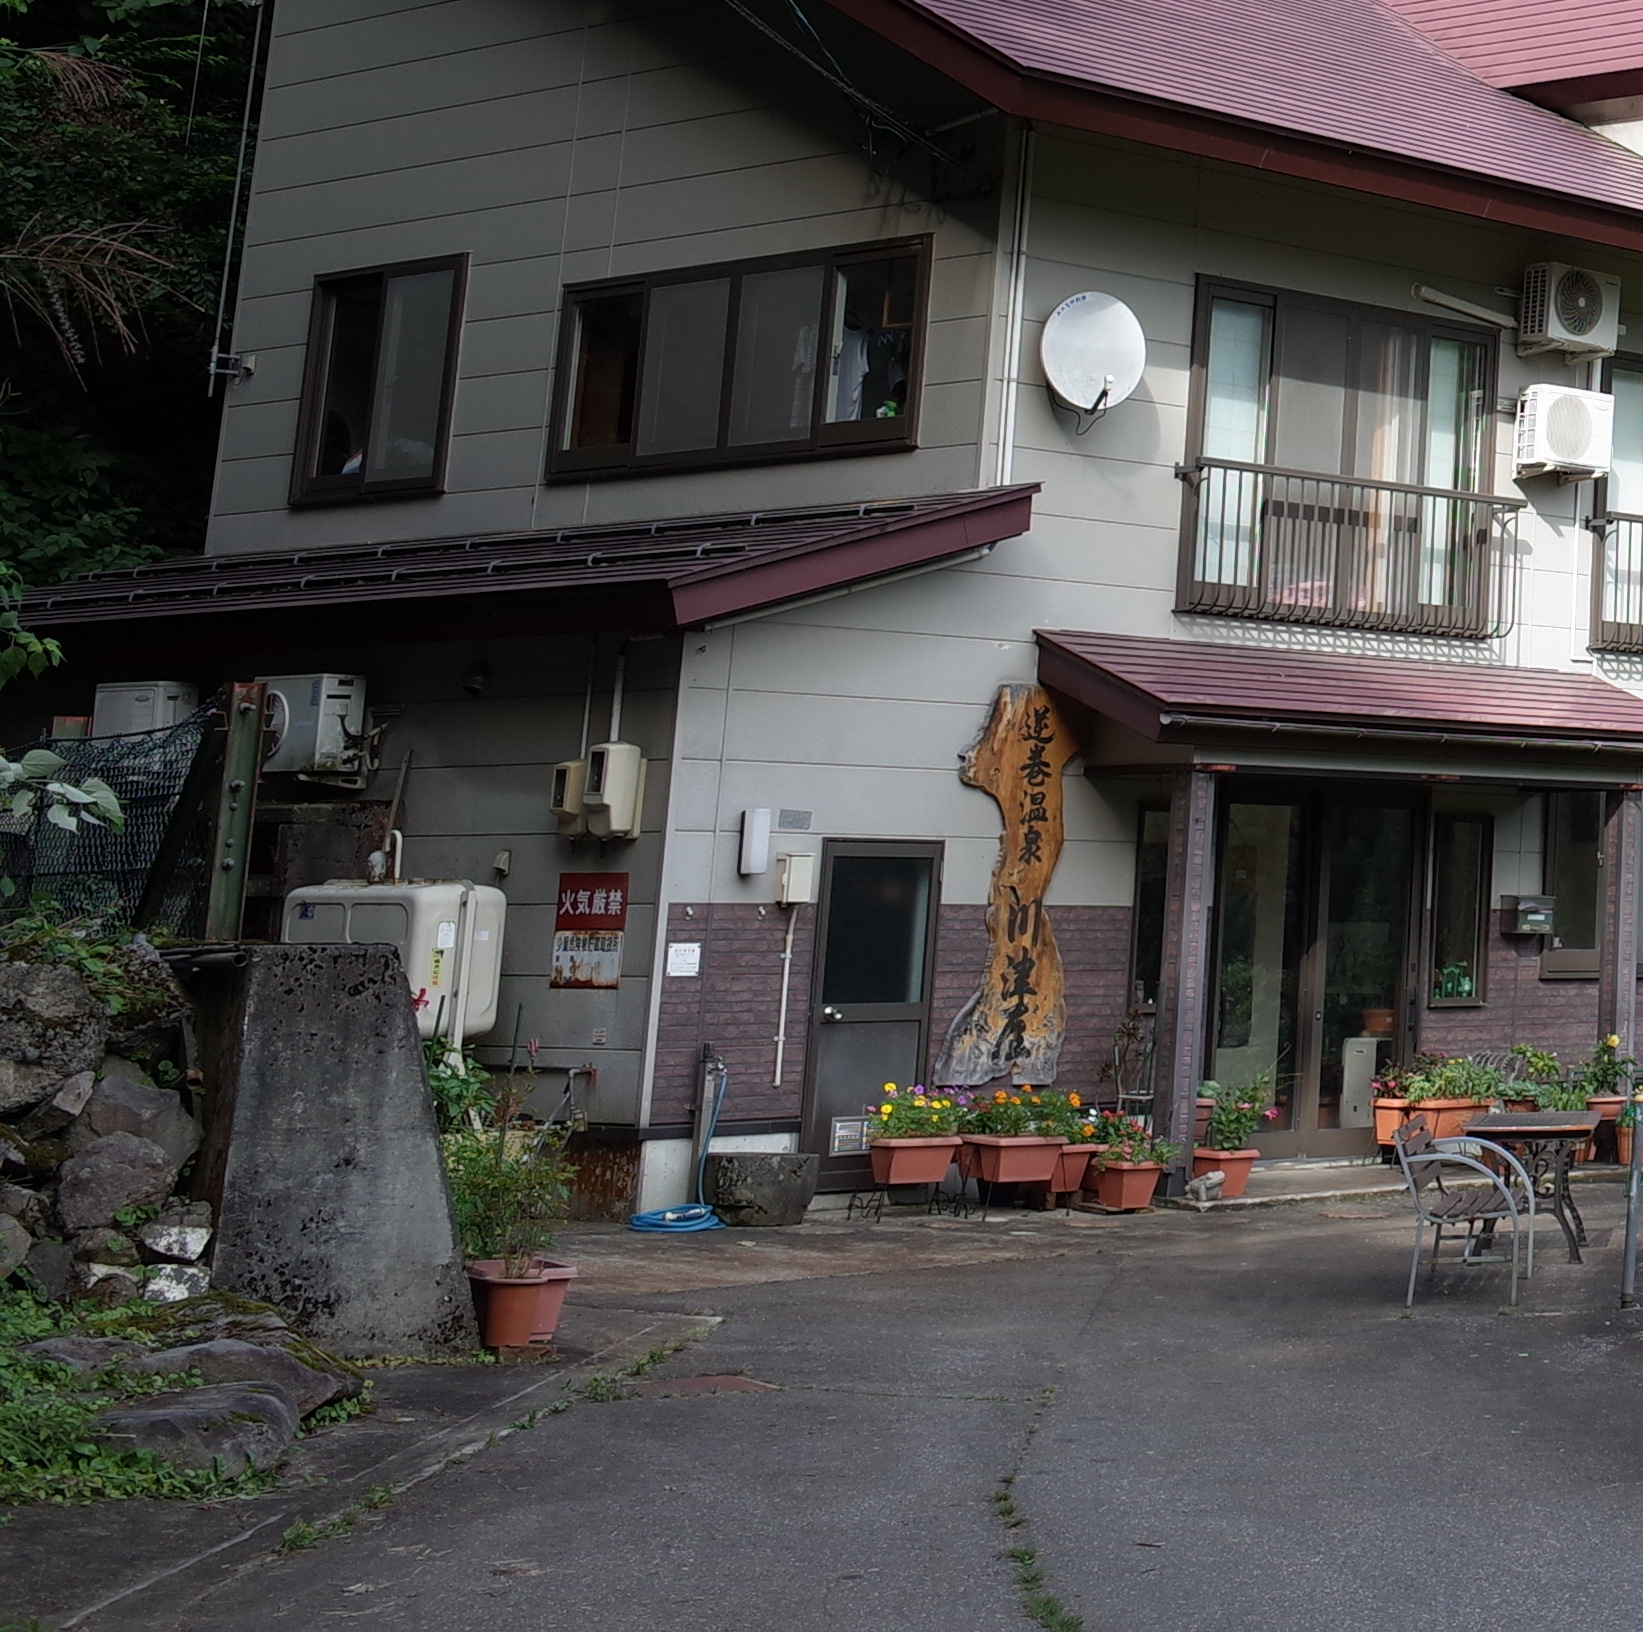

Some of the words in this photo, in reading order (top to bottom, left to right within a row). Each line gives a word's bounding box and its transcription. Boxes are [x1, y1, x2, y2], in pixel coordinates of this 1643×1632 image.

[1019, 705, 1055, 865] 逆巻温泉
[559, 888, 623, 916] 火気厳禁
